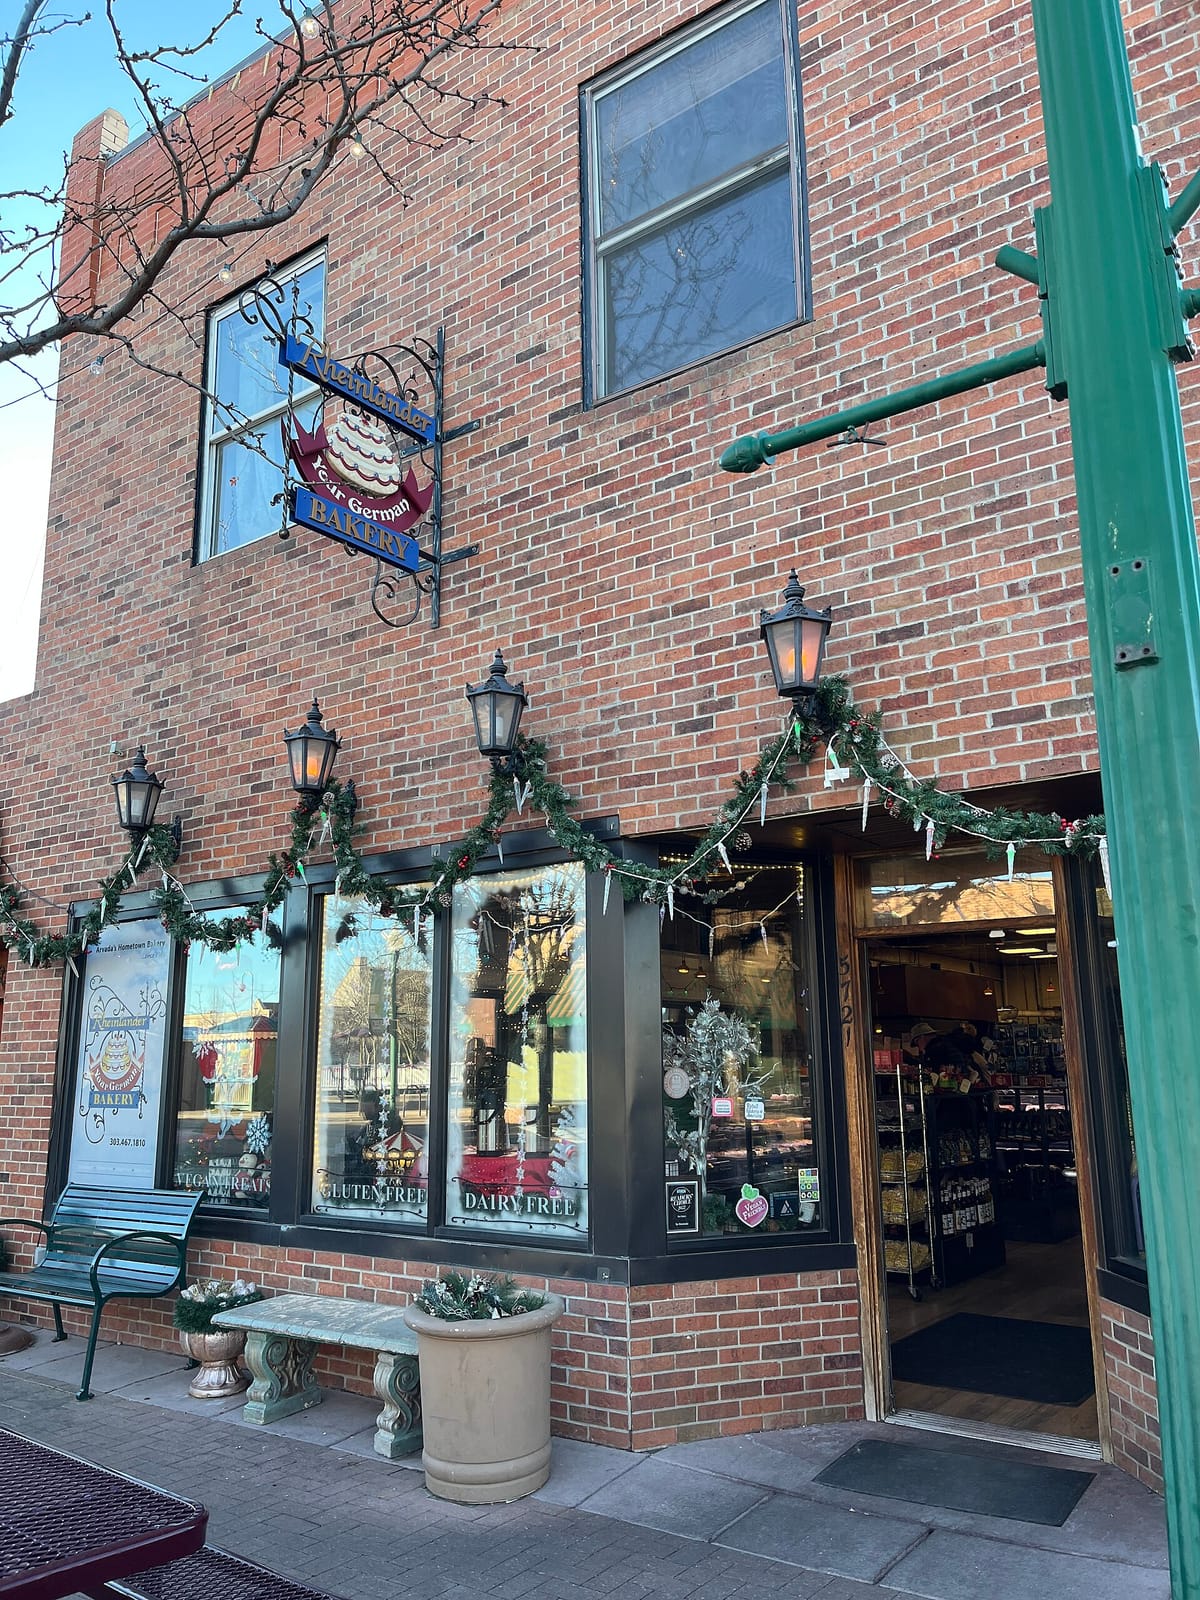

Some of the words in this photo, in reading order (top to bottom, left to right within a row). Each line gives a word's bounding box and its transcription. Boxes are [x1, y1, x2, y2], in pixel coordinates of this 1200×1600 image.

[311, 455, 346, 500] Your
[347, 497, 410, 523] German
[310, 496, 409, 561] BAKERY
[118, 942, 146, 951] Hometown
[839, 954, 853, 1048] 5721
[95, 1068, 109, 1091] Your
[109, 1068, 138, 1091] German
[93, 1093, 134, 1105] BAKERY
[109, 1137, 146, 1147] 303.467.1810
[176, 1172, 219, 1189] VEGAN
[321, 1182, 381, 1201] GLUTEN
[386, 1186, 427, 1204] FREE
[464, 1192, 520, 1212] DAIRY
[527, 1196, 575, 1216] FREE
